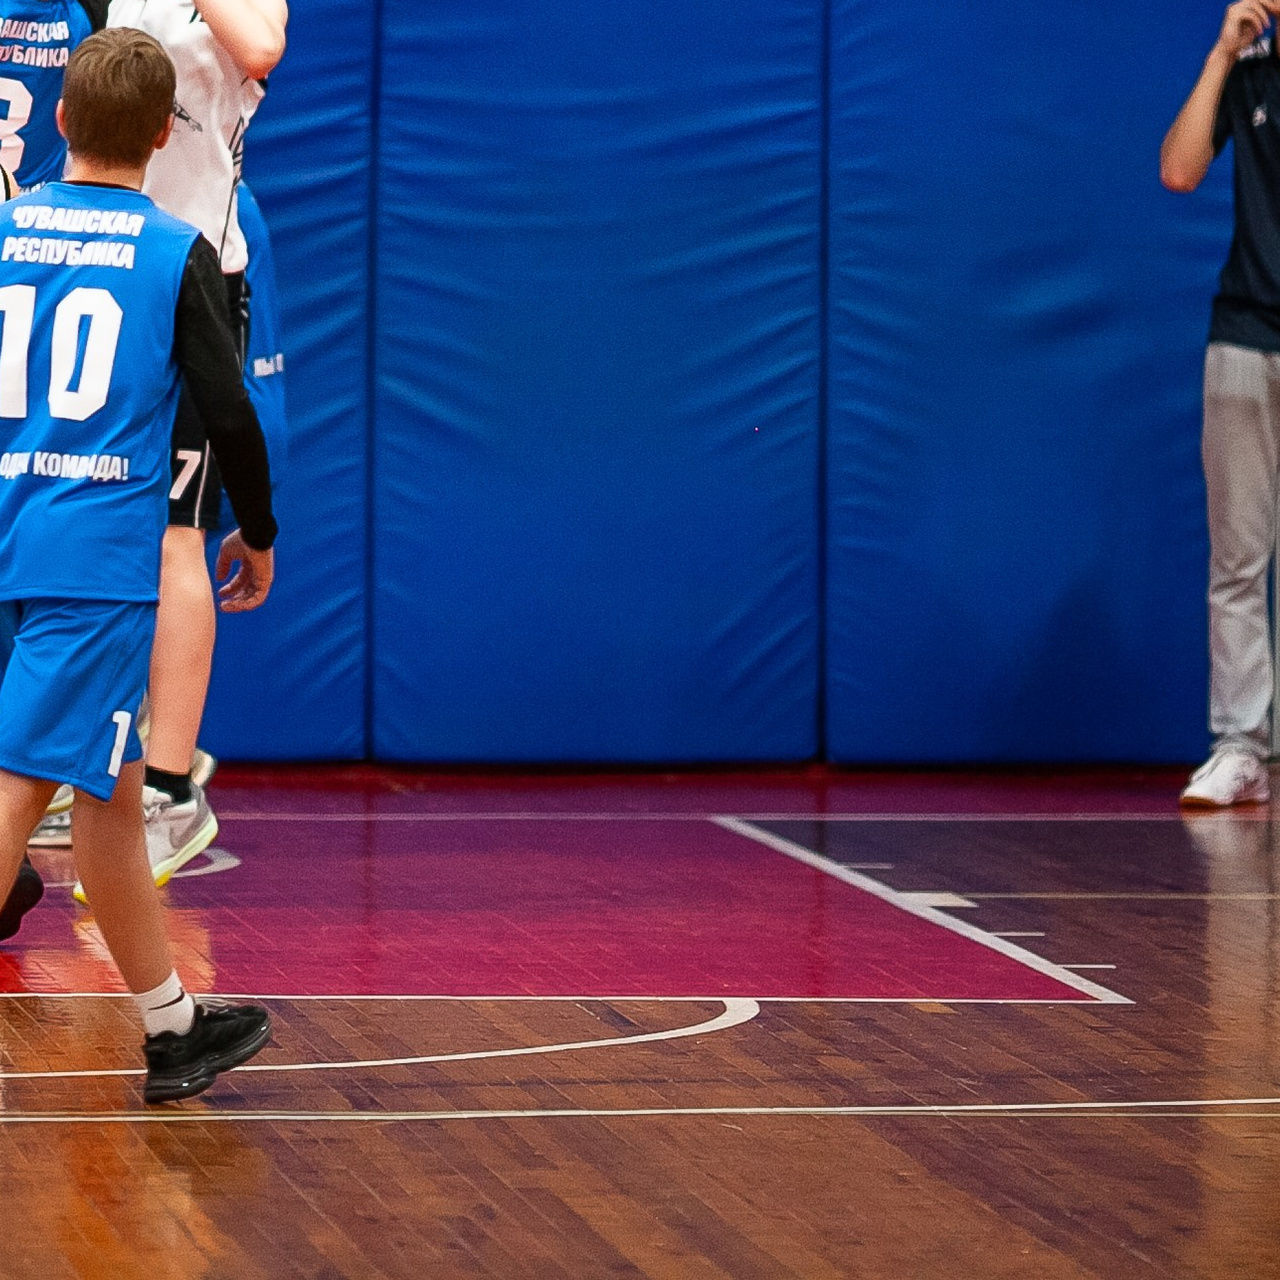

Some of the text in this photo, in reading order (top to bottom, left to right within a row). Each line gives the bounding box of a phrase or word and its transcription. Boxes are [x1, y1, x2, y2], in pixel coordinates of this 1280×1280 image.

[12, 205, 146, 237] ЧУВАШСКАЯ
[1, 237, 136, 269] РЕСПУБЛИКА
[169, 449, 202, 500] 7
